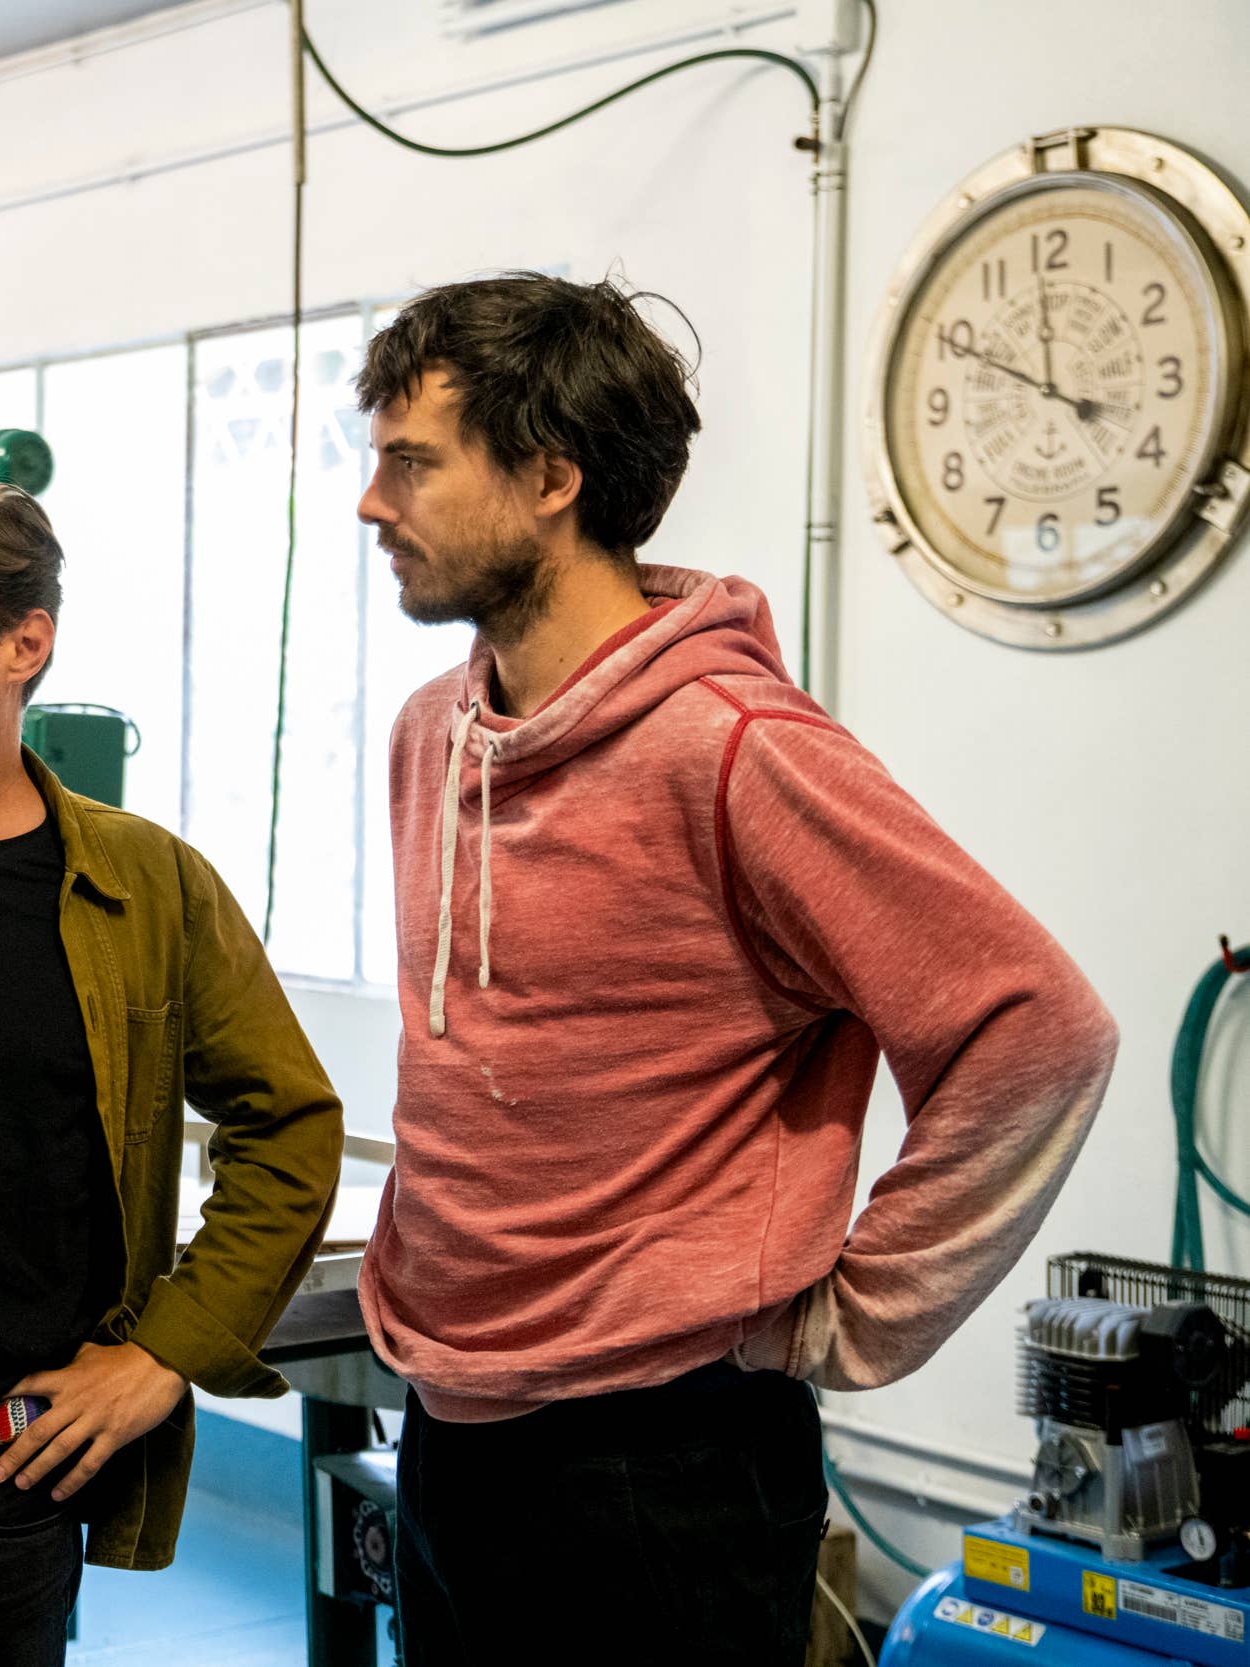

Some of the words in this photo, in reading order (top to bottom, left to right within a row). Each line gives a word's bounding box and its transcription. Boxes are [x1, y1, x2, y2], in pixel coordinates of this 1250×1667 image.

[1031, 228, 1069, 273] 12
[1105, 241, 1113, 284] 1
[982, 257, 1006, 300] 11
[1141, 282, 1167, 327] 2
[937, 318, 974, 361] 10
[1156, 355, 1184, 400] 3
[927, 387, 949, 427] 9
[1135, 425, 1167, 469] 4
[942, 450, 965, 492] 8
[983, 495, 1007, 536] 7
[1093, 485, 1122, 527] 5
[1036, 511, 1060, 553] 6
